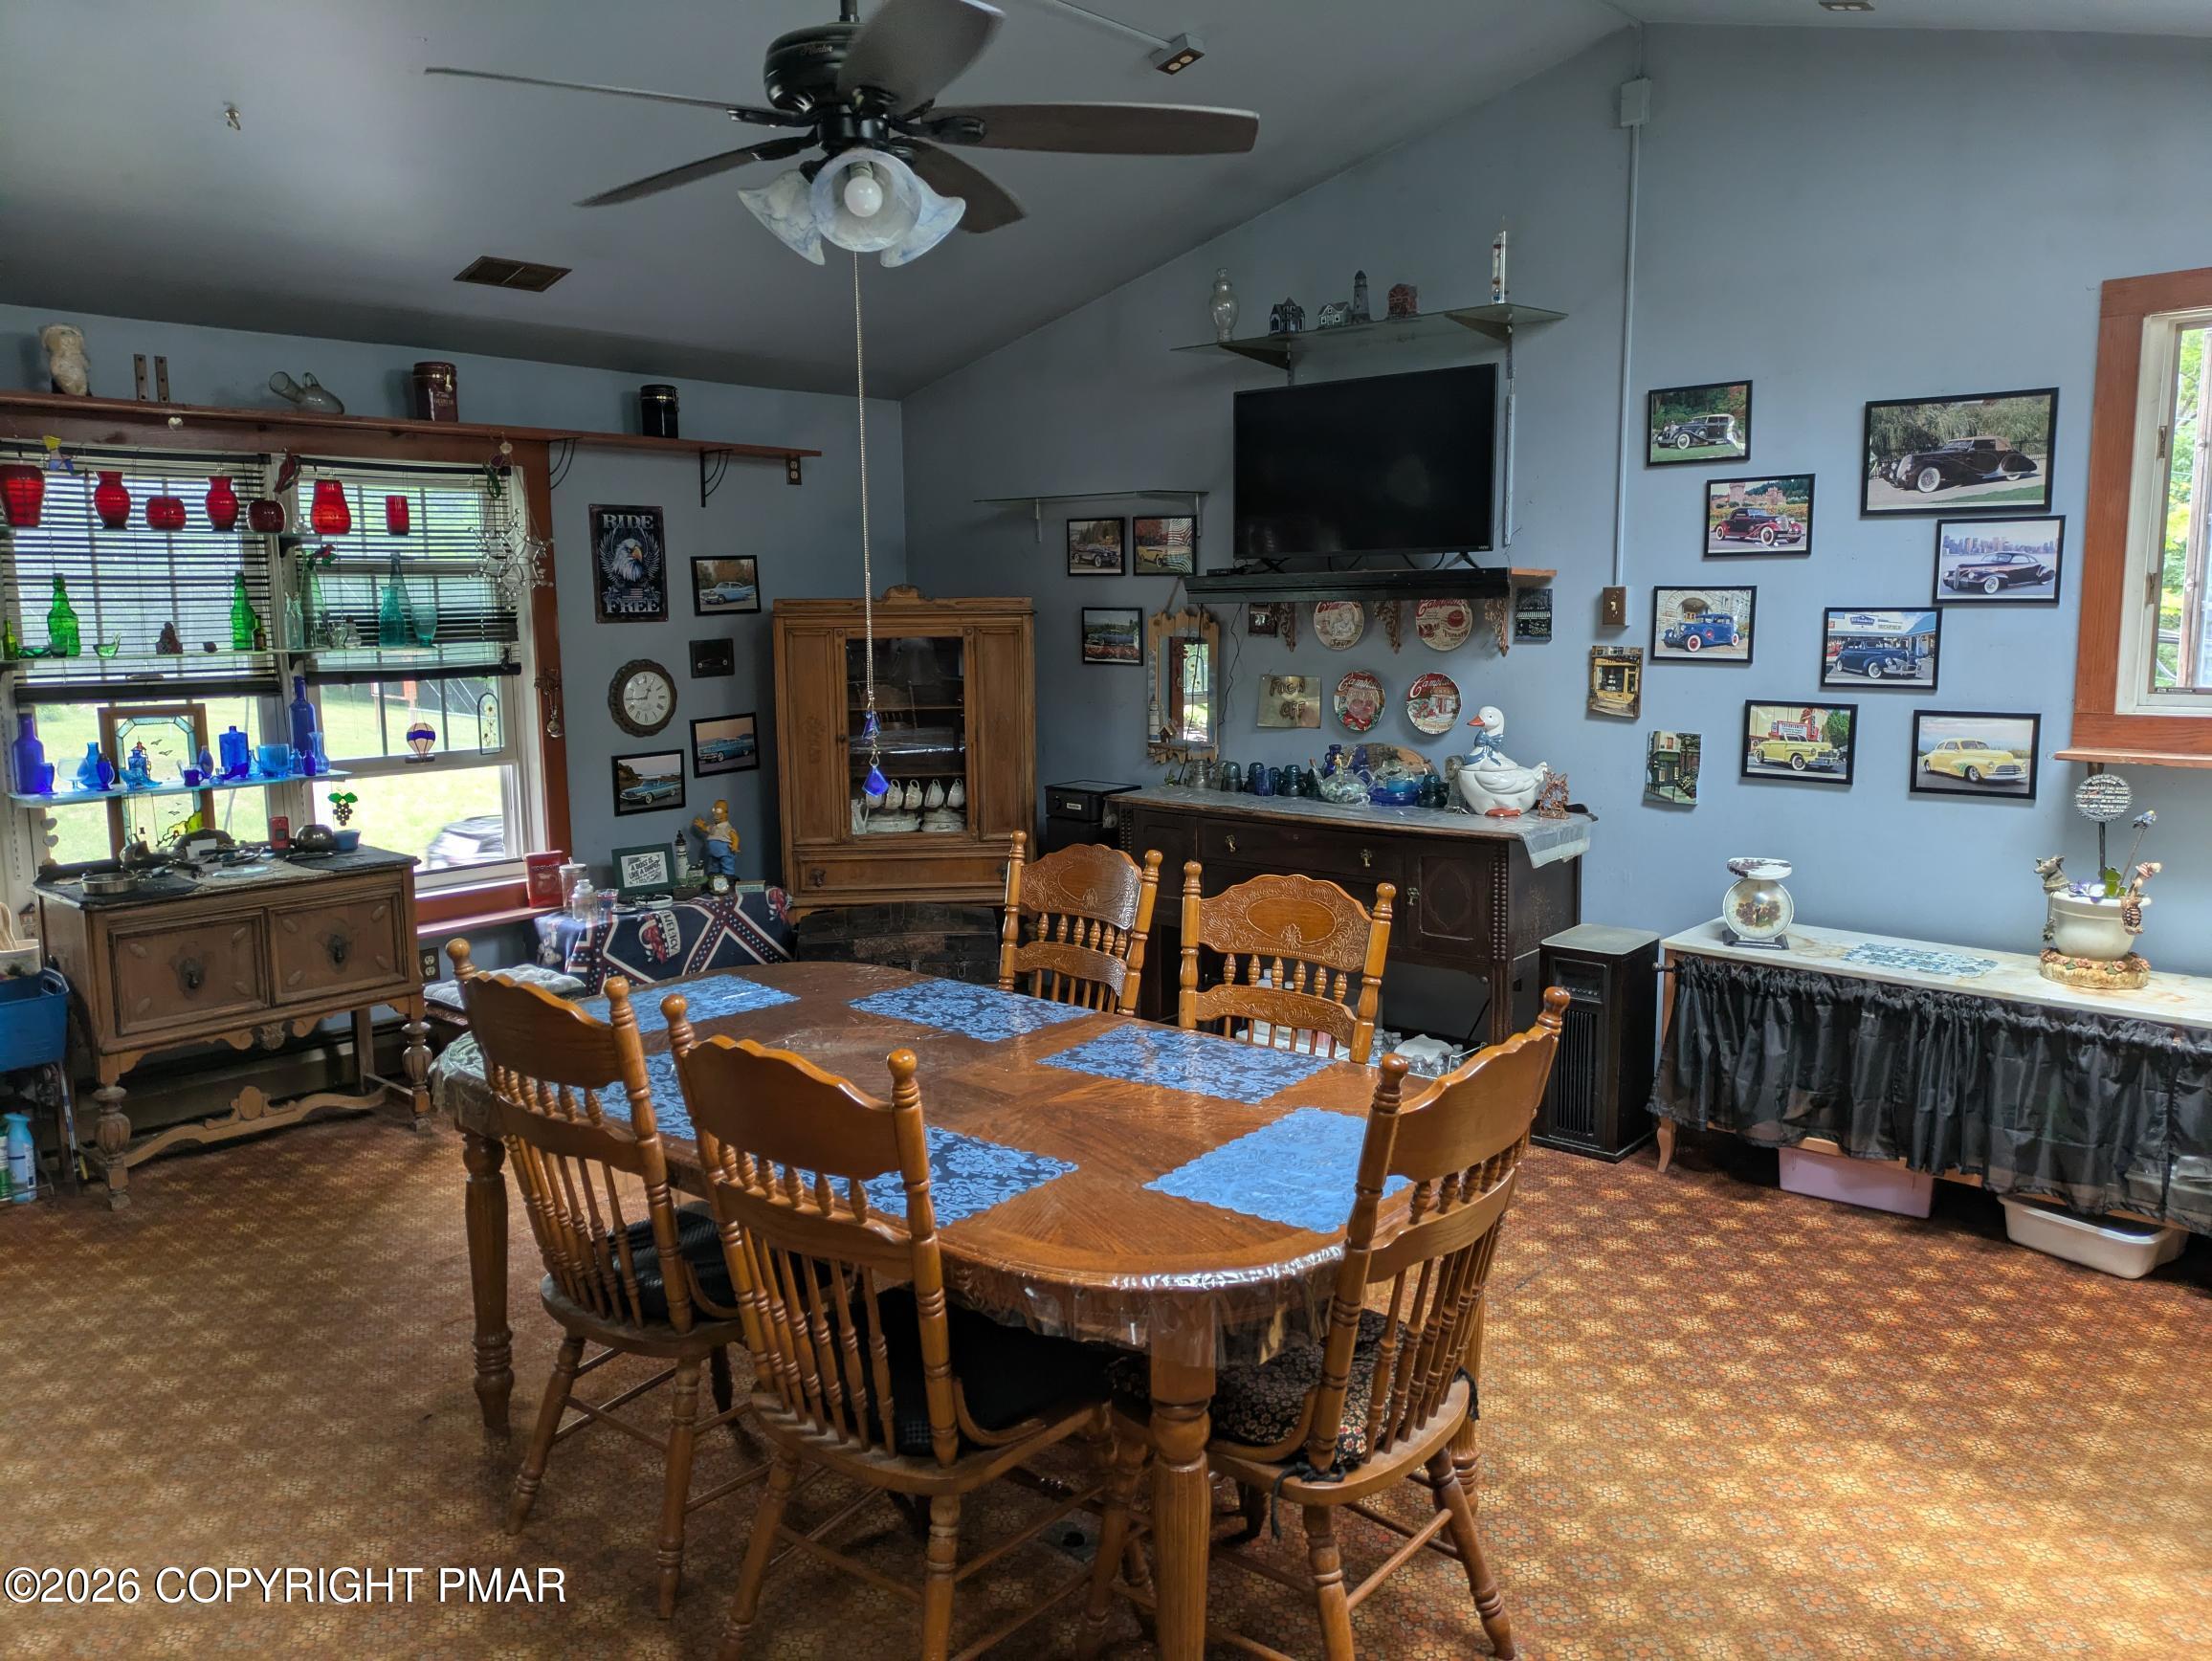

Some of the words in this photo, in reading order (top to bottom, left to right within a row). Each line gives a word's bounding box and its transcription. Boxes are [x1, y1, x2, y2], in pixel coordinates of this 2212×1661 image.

[602, 514, 653, 529] RIDE
[606, 599, 660, 613] FREE
[634, 858, 649, 870] BOSS
